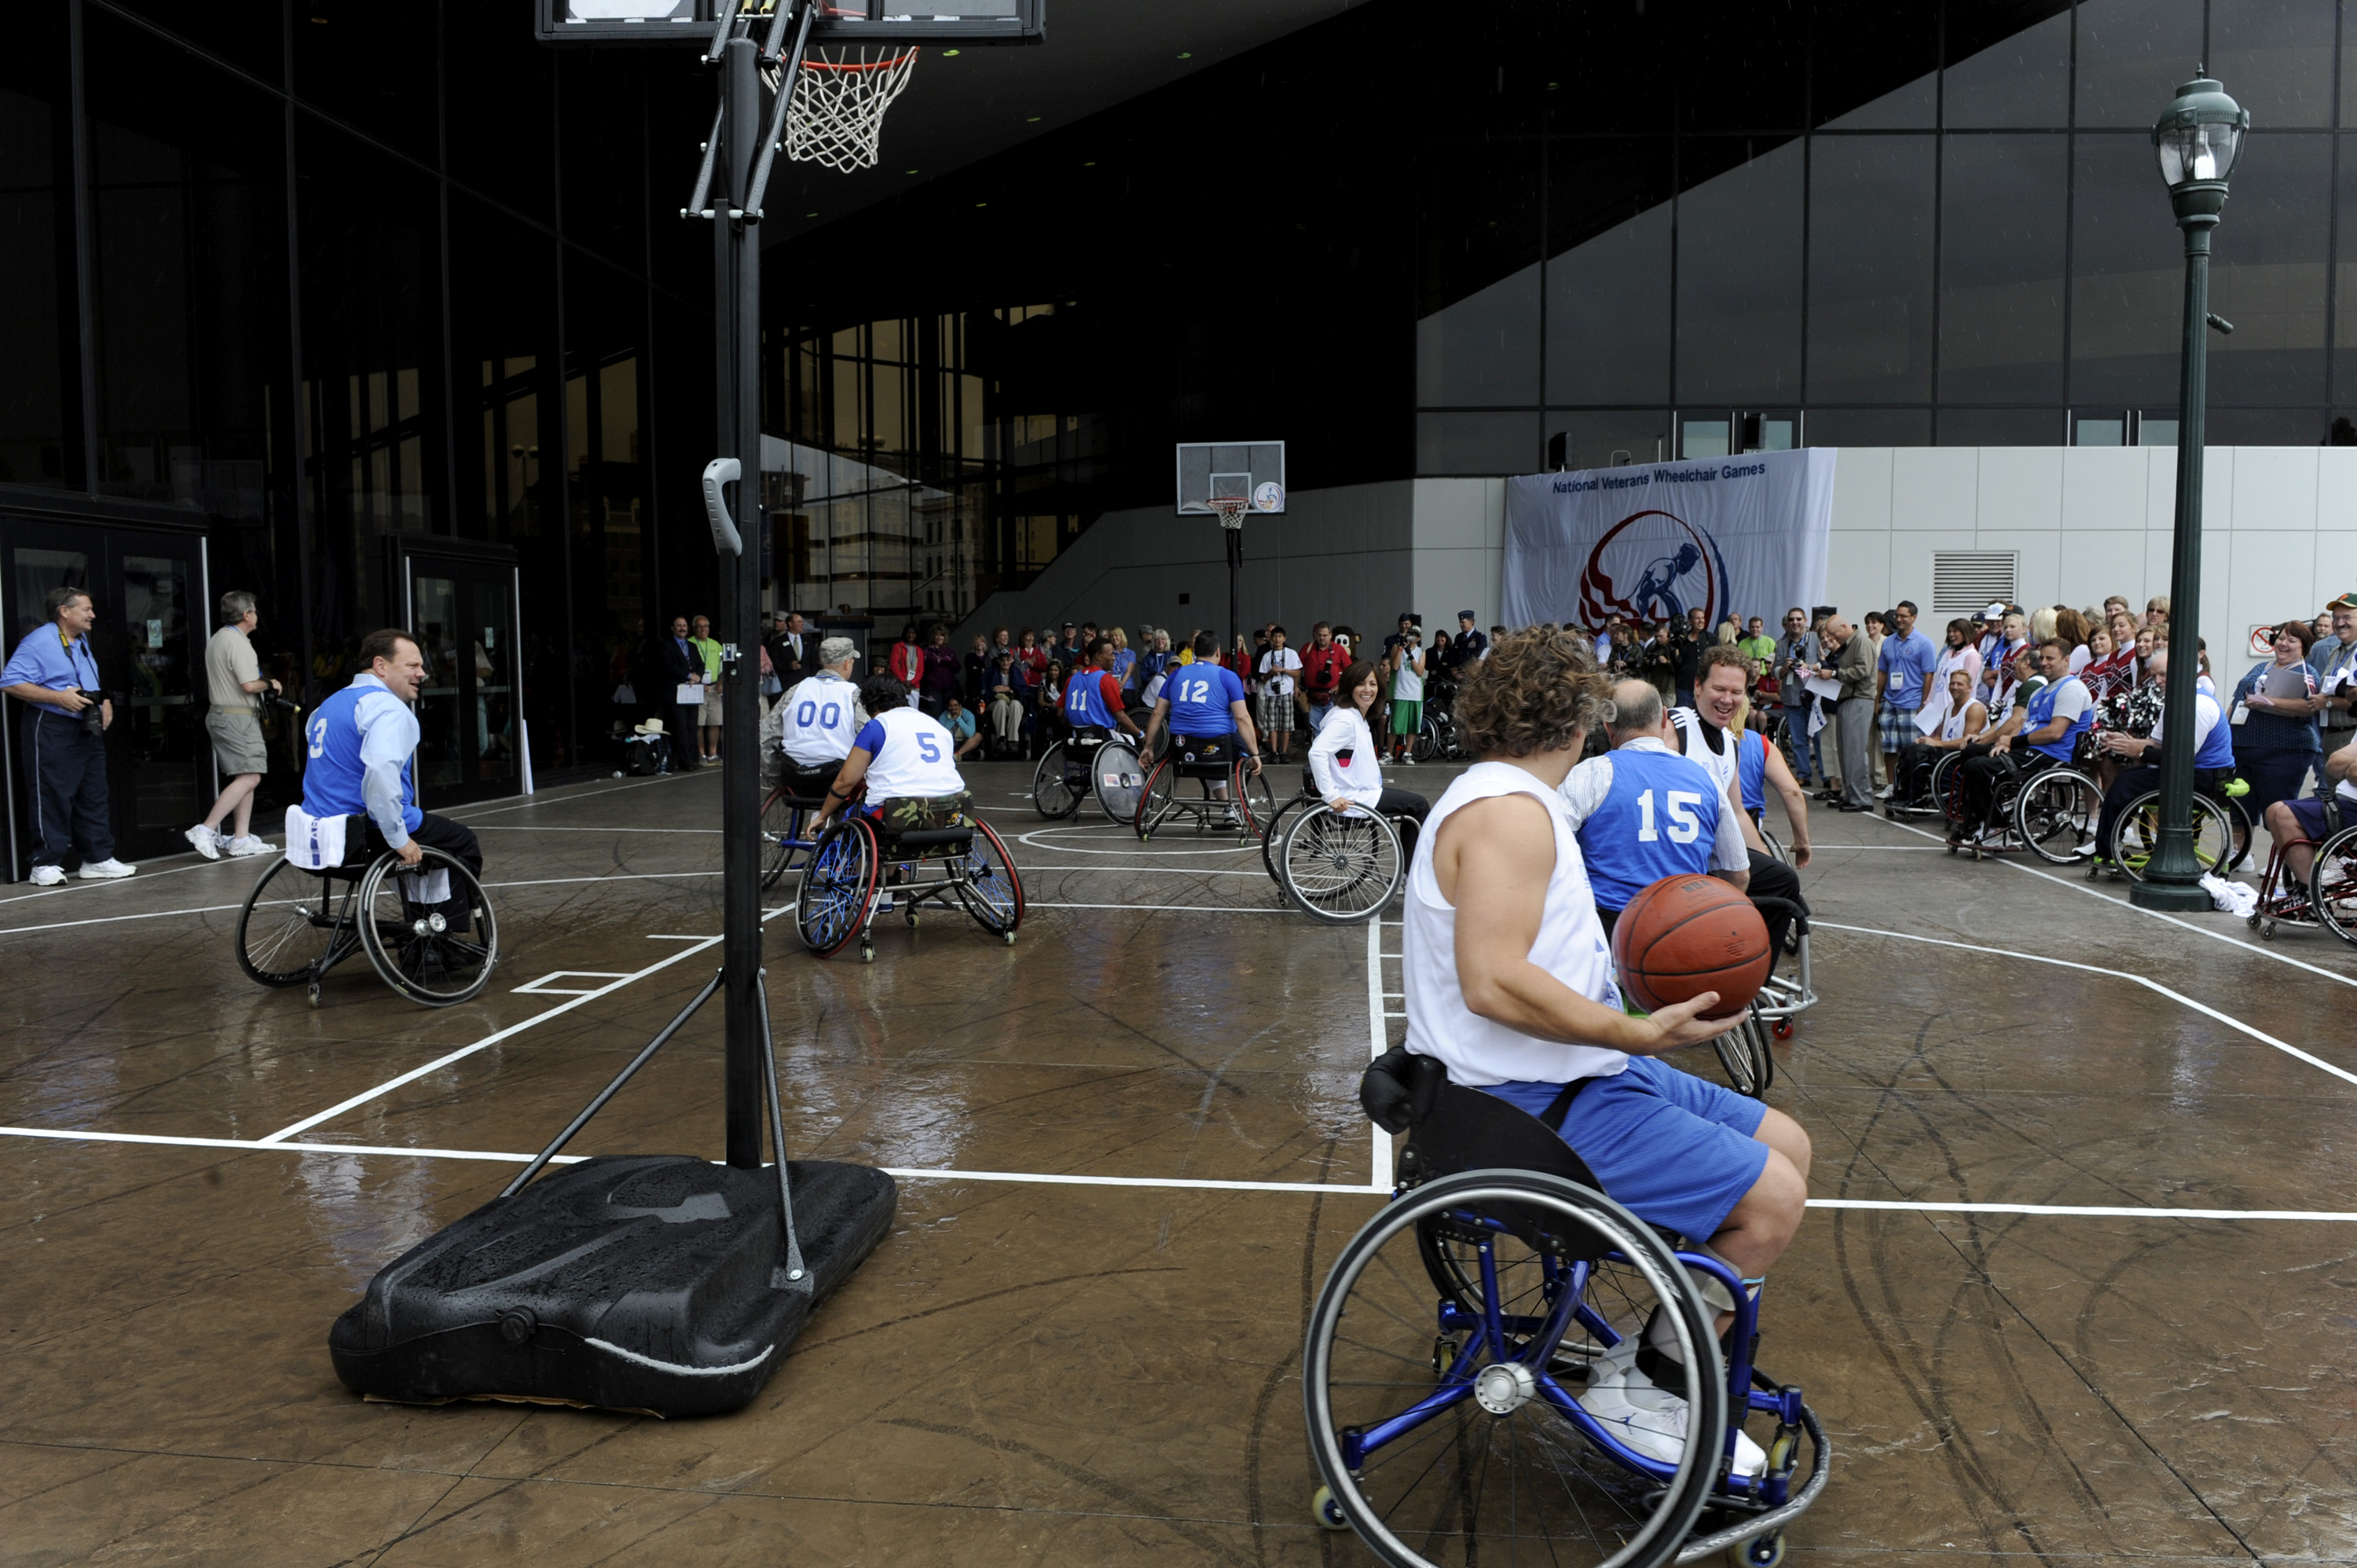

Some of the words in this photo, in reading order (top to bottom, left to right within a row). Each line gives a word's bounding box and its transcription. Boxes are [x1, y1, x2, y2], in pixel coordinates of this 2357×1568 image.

[1552, 478, 1599, 494] National
[1601, 473, 1650, 490] Veterans
[1653, 468, 1718, 484] Wheelchair
[1721, 463, 1765, 479] Games
[1070, 689, 1087, 711] 11
[1179, 679, 1209, 703] 12
[797, 701, 841, 730] 00
[309, 717, 328, 759] 3
[915, 732, 941, 764] 5
[1637, 789, 1702, 844] 15
[1681, 879, 1713, 893] NBA
